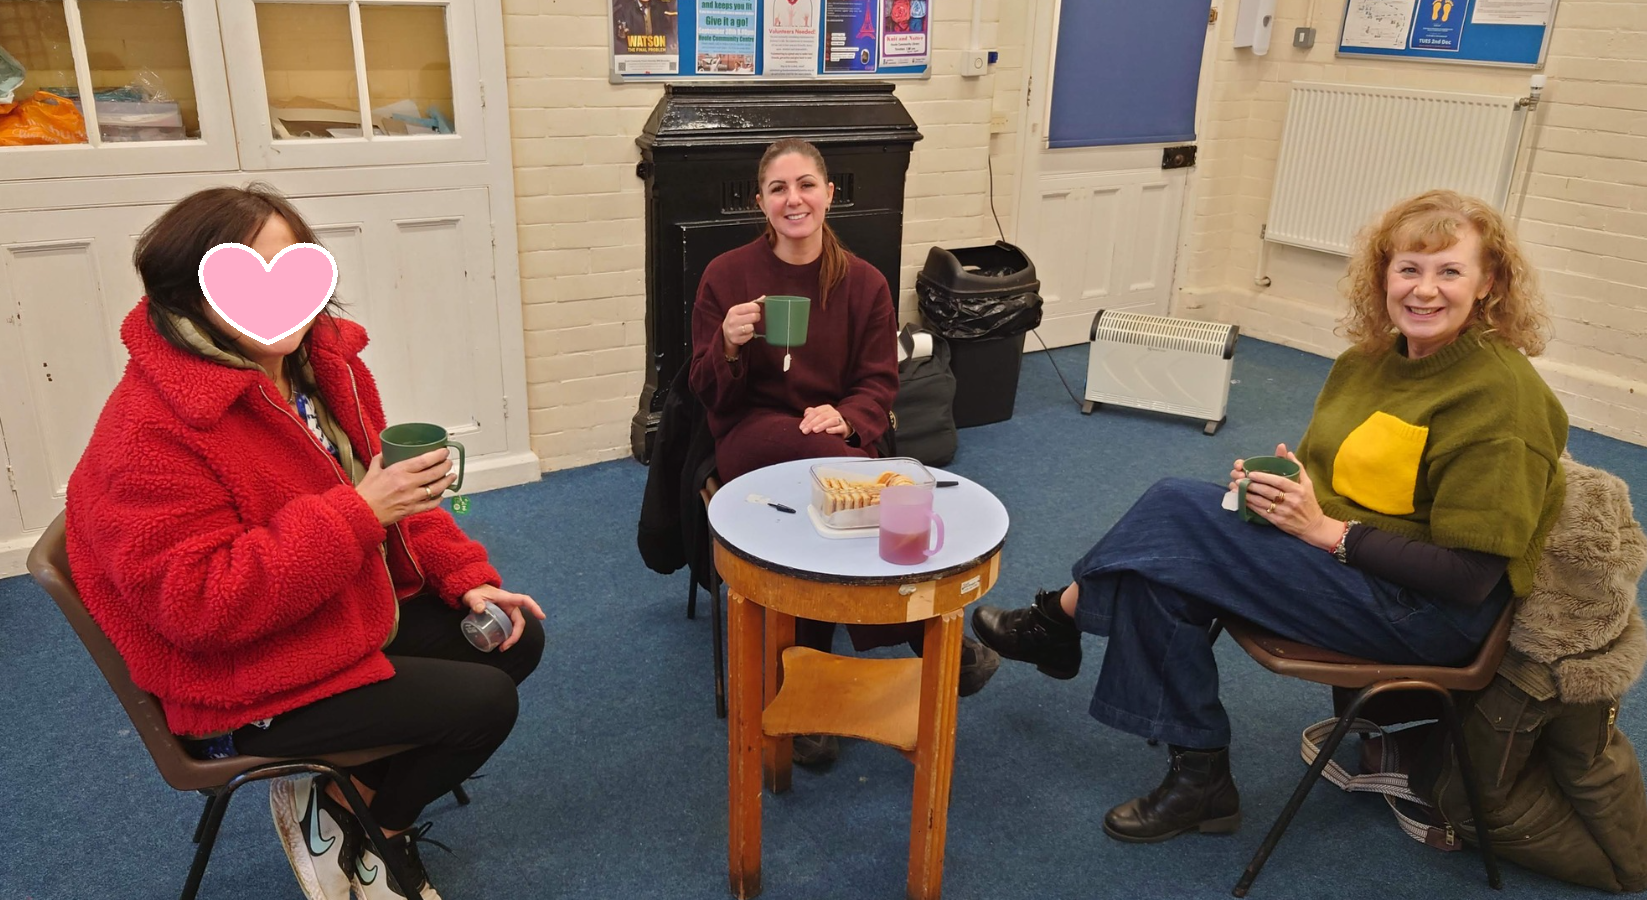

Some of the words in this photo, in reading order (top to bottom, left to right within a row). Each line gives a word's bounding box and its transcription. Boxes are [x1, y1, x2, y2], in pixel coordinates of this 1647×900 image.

[715, 1, 733, 10] keeps
[705, 16, 721, 26] Give
[723, 17, 729, 26] it
[736, 18, 748, 27] go!
[627, 35, 666, 47] WATSON
